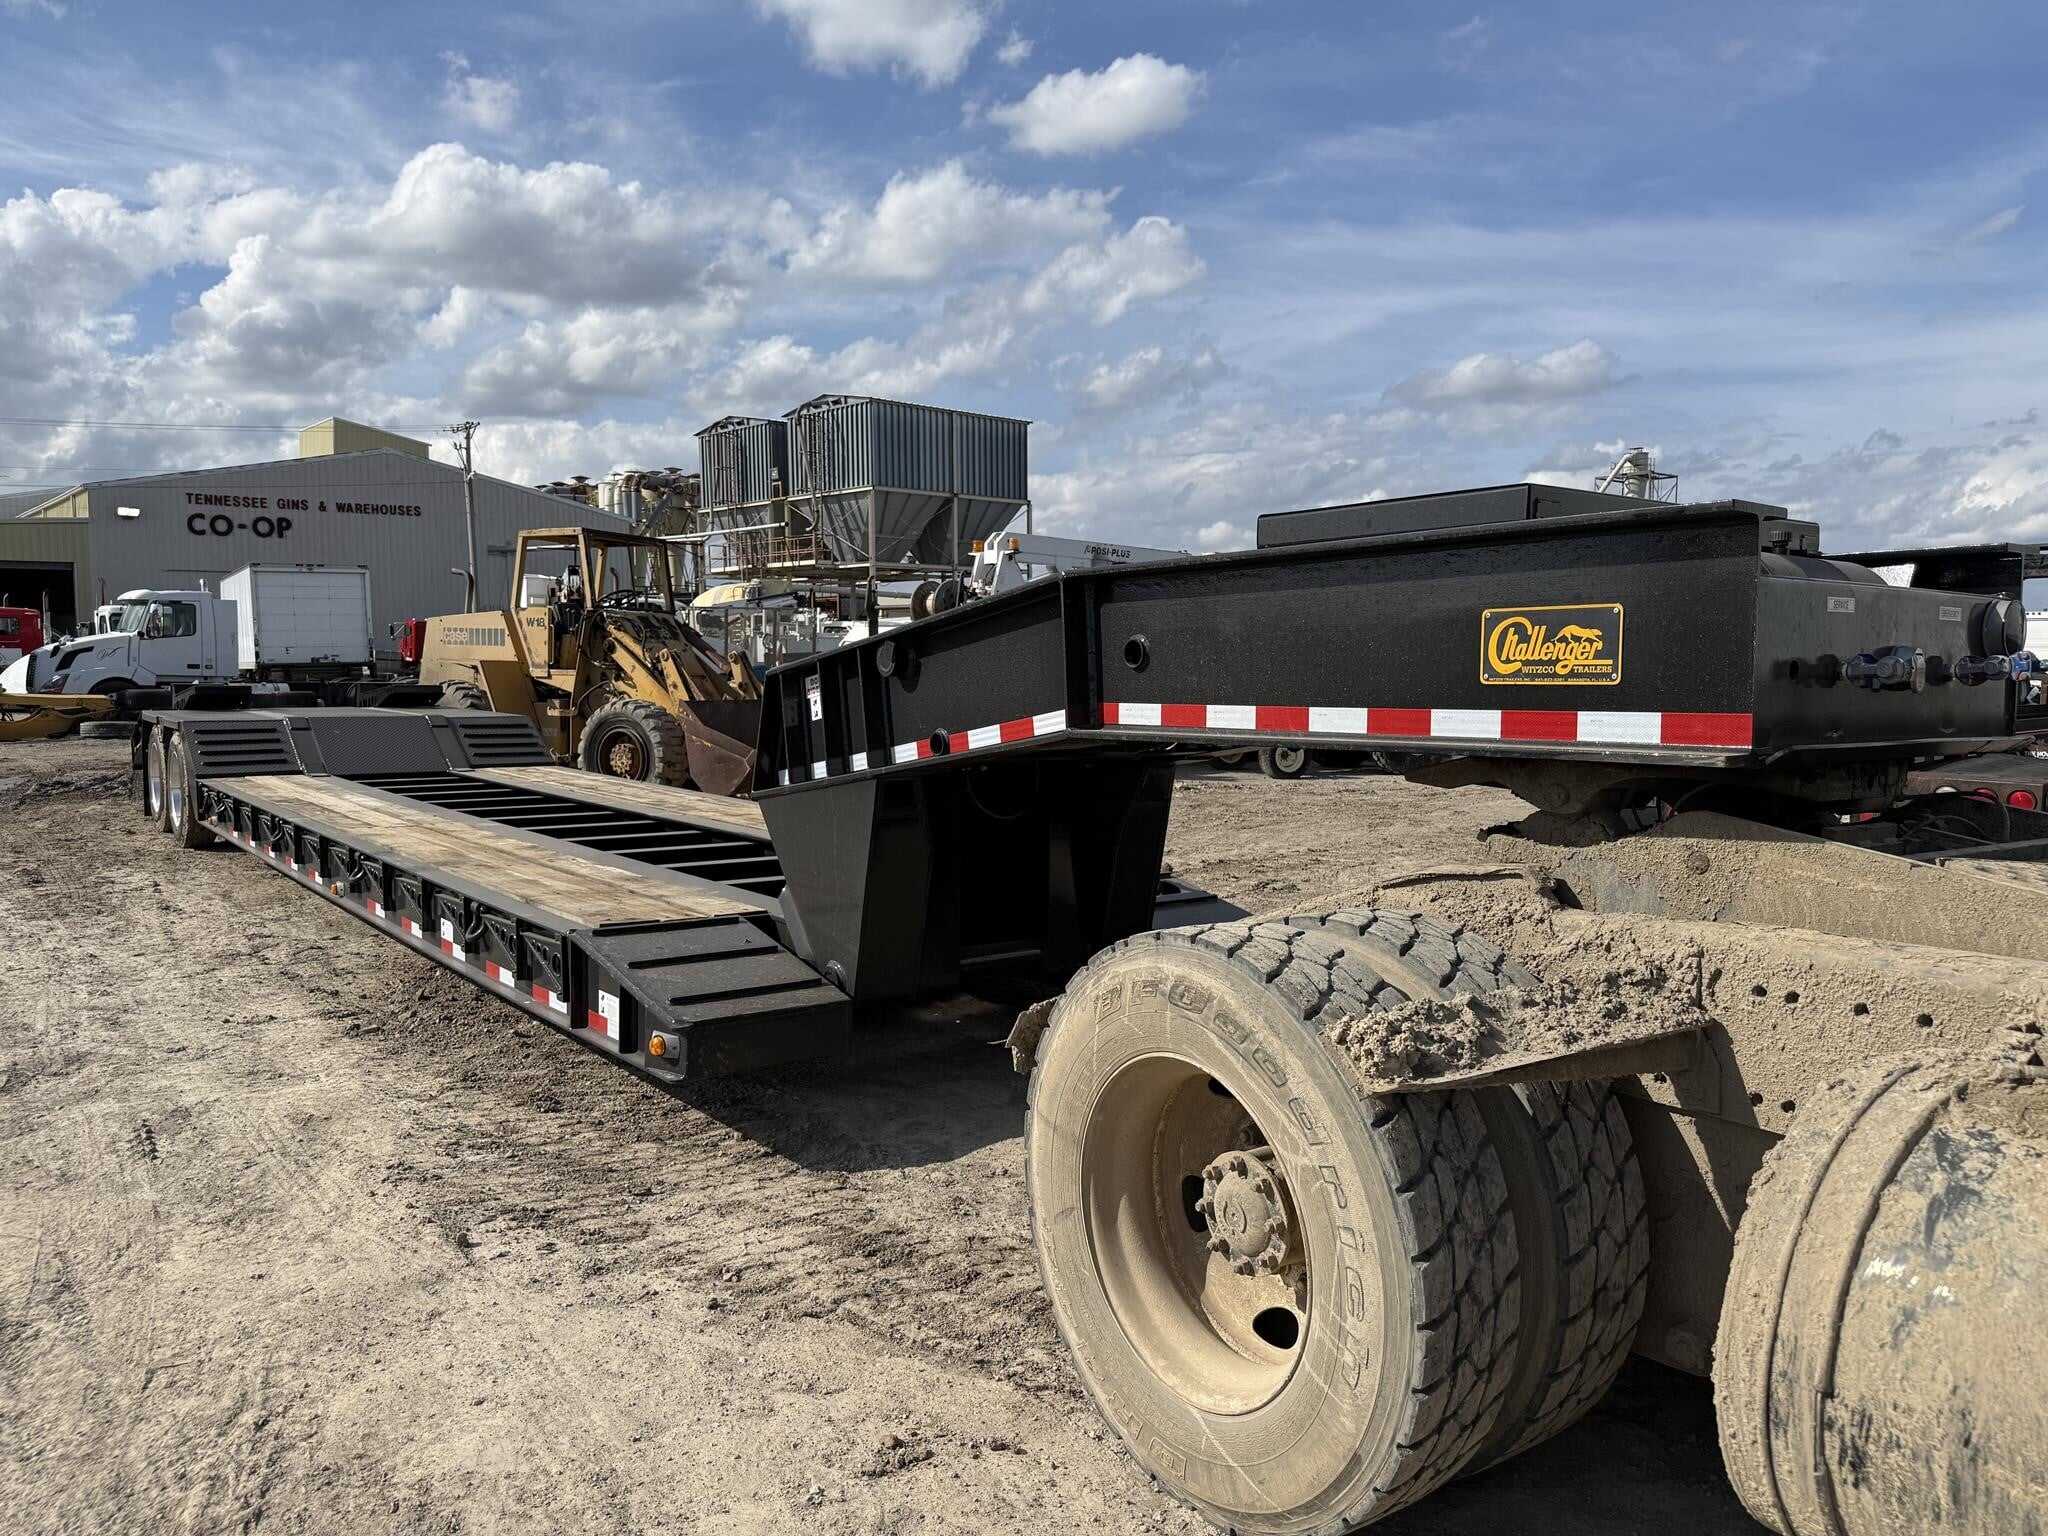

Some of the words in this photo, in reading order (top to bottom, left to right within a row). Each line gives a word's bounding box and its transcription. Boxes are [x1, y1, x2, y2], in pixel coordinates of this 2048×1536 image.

[185, 492, 268, 509] TENNESSEE
[277, 498, 309, 511] GINS
[318, 501, 327, 512] &
[335, 502, 422, 517] WAREHOUSES
[186, 512, 293, 539] CO-OP
[1488, 616, 1613, 675] Challenger
[1573, 665, 1613, 673] TRAILERS
